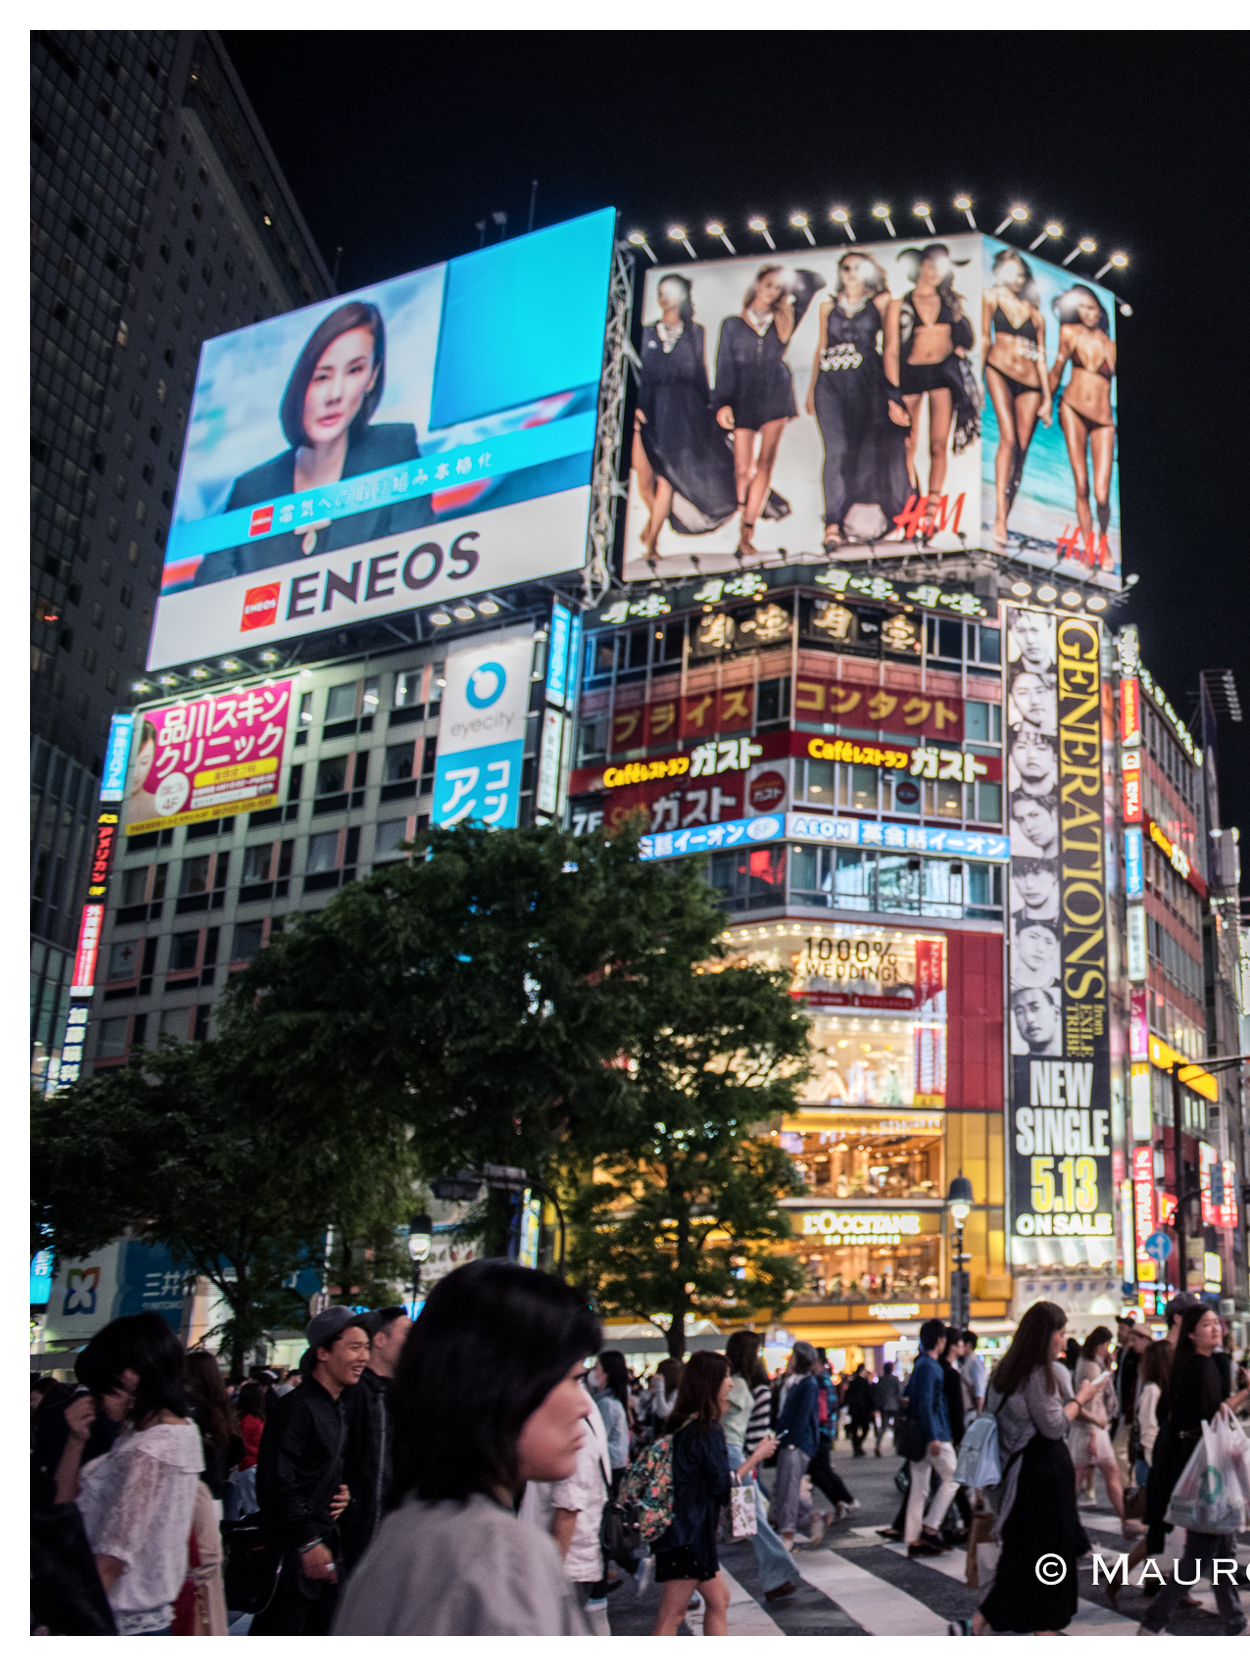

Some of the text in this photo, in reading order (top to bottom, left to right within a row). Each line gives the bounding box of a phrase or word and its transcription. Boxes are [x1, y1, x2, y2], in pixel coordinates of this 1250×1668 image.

[893, 491, 966, 540] H&M
[1056, 523, 1108, 566] H&M
[285, 530, 481, 621] ENEOS
[244, 598, 278, 616] ENEOS
[158, 691, 289, 747] 品川スキン
[450, 710, 516, 740] eyecity
[614, 689, 748, 742] プライス
[796, 681, 958, 729] コンタクト
[155, 722, 284, 779] クリニック
[690, 737, 763, 777] ガスト
[910, 747, 988, 783] ガスト
[651, 787, 737, 833] ガスト
[754, 789, 783, 801] ガスト
[1058, 618, 1105, 999] GENERATIONS
[572, 812, 603, 836] 7F
[793, 818, 1006, 856] AEON 英会話イーオン
[805, 936, 897, 965] 1000%
[1066, 1003, 1080, 1057] TRIBE
[1080, 1004, 1094, 1057] EXILE
[1095, 1004, 1106, 1035] from
[1029, 1060, 1094, 1108] NEW
[1016, 1107, 1110, 1156] SINGLE
[1031, 1156, 1098, 1213] 5.13
[1016, 1214, 1113, 1236] ON SALE
